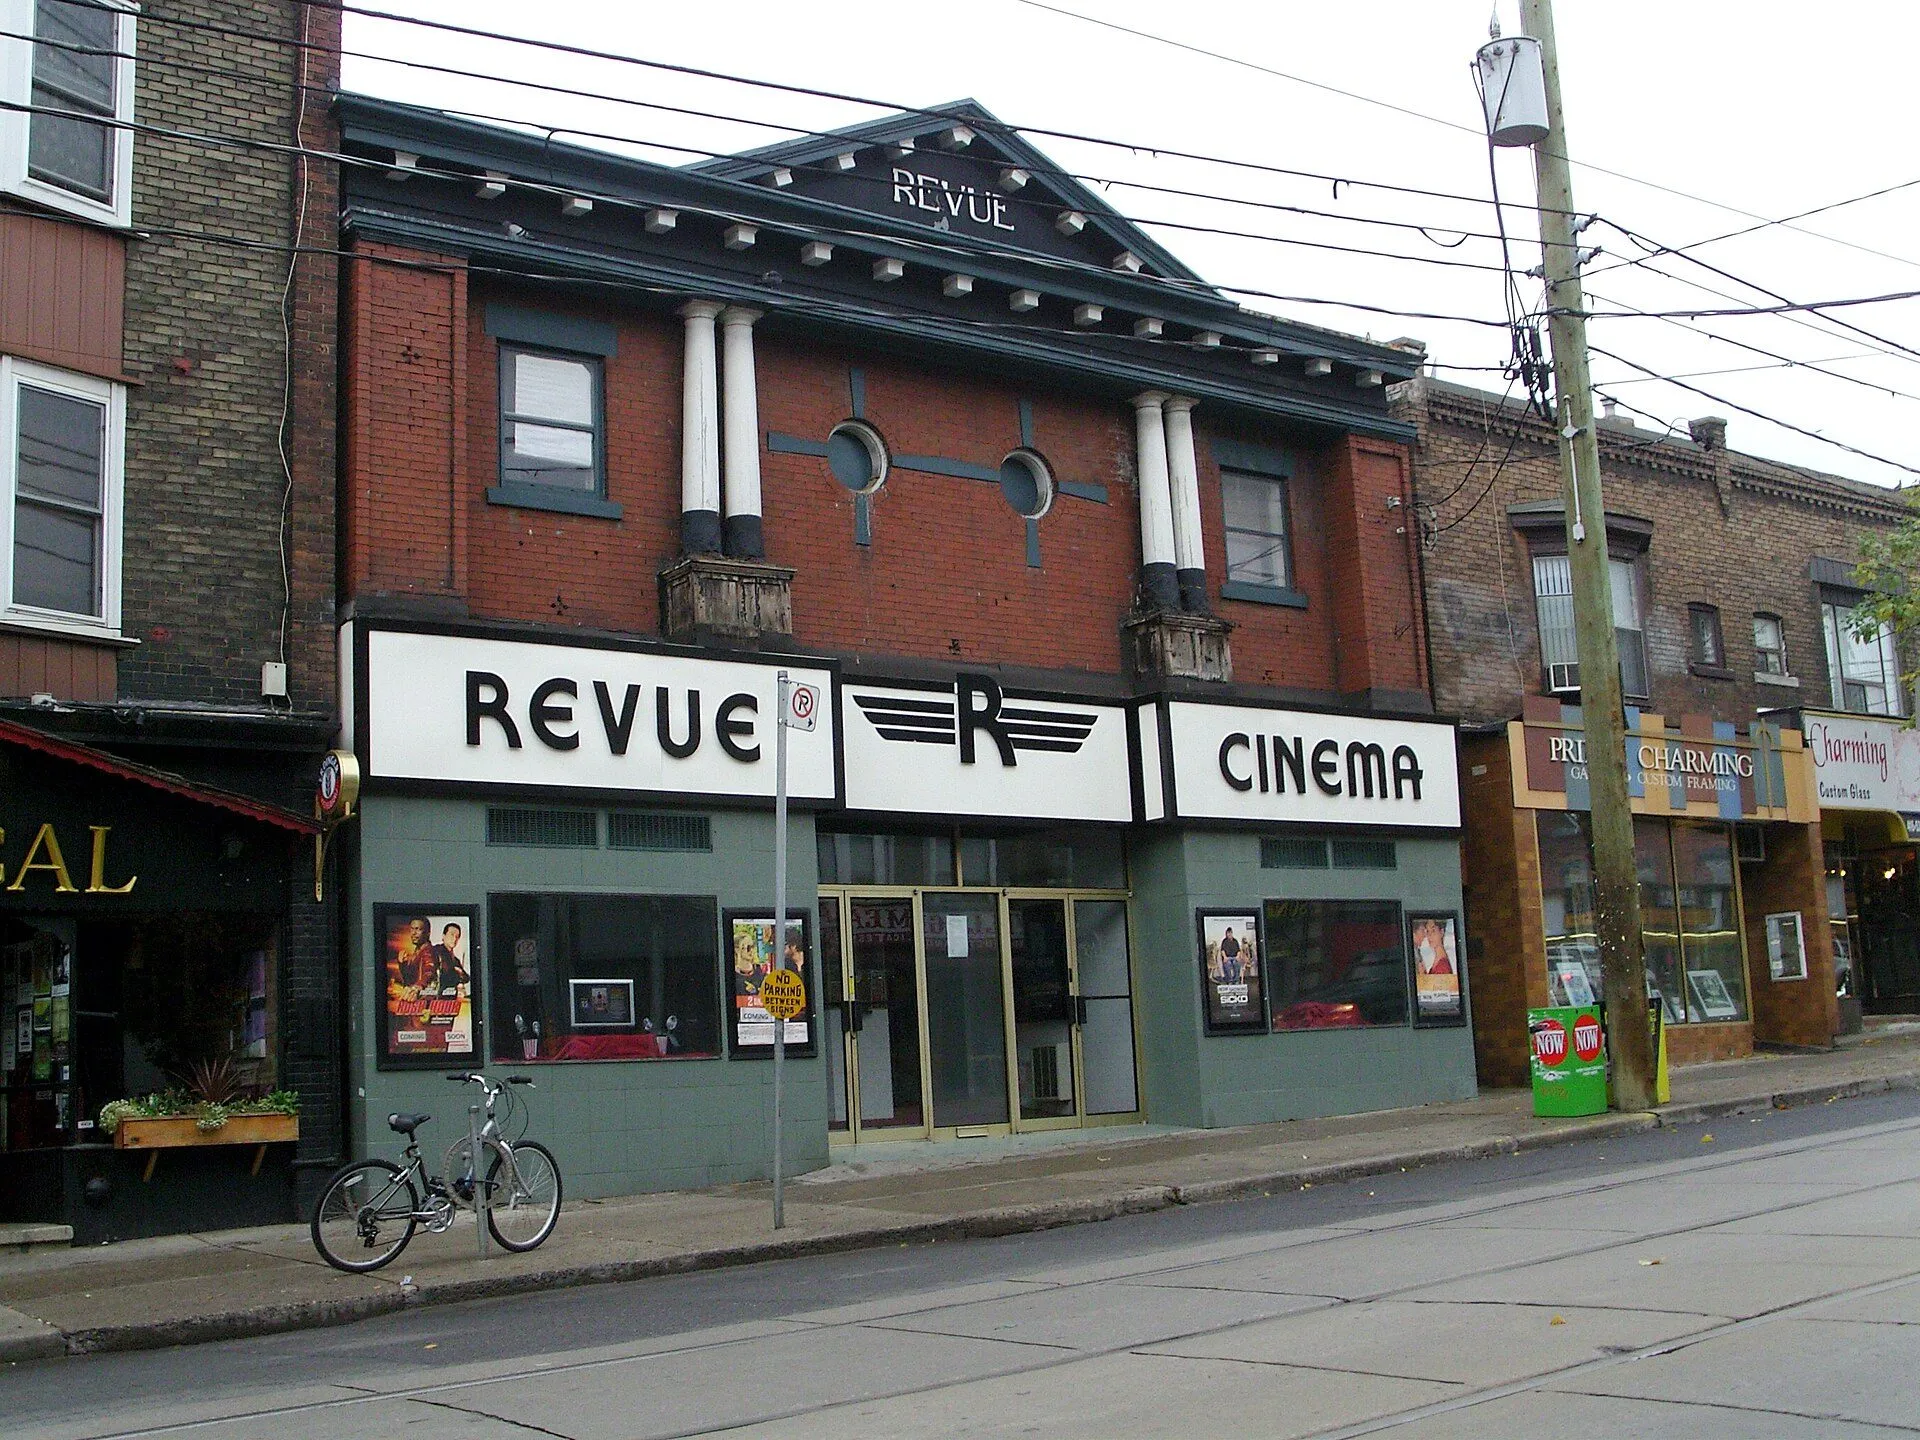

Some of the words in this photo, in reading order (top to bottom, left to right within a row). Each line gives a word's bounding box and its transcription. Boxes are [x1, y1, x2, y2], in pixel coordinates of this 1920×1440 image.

[892, 167, 1015, 231] REVUE
[465, 670, 762, 763] REVUE
[957, 672, 1017, 766] R
[1550, 736, 1588, 764] PRI
[1637, 745, 1753, 778] CHARMING
[1804, 722, 1888, 782] Charming
[1218, 732, 1424, 800] CINEMA
[1637, 771, 1683, 788] CUSTOM
[1686, 776, 1737, 791] FRAMING
[1819, 782, 1848, 798] Custom
[1850, 783, 1871, 799] Glass
[0, 823, 138, 893] AL
[764, 982, 802, 997] PARKING
[775, 974, 791, 985] NO
[765, 997, 801, 1006] BETWEEN
[770, 1005, 795, 1014] SIGNS
[1535, 1032, 1564, 1055] NOW
[1575, 1028, 1599, 1052] NOW
